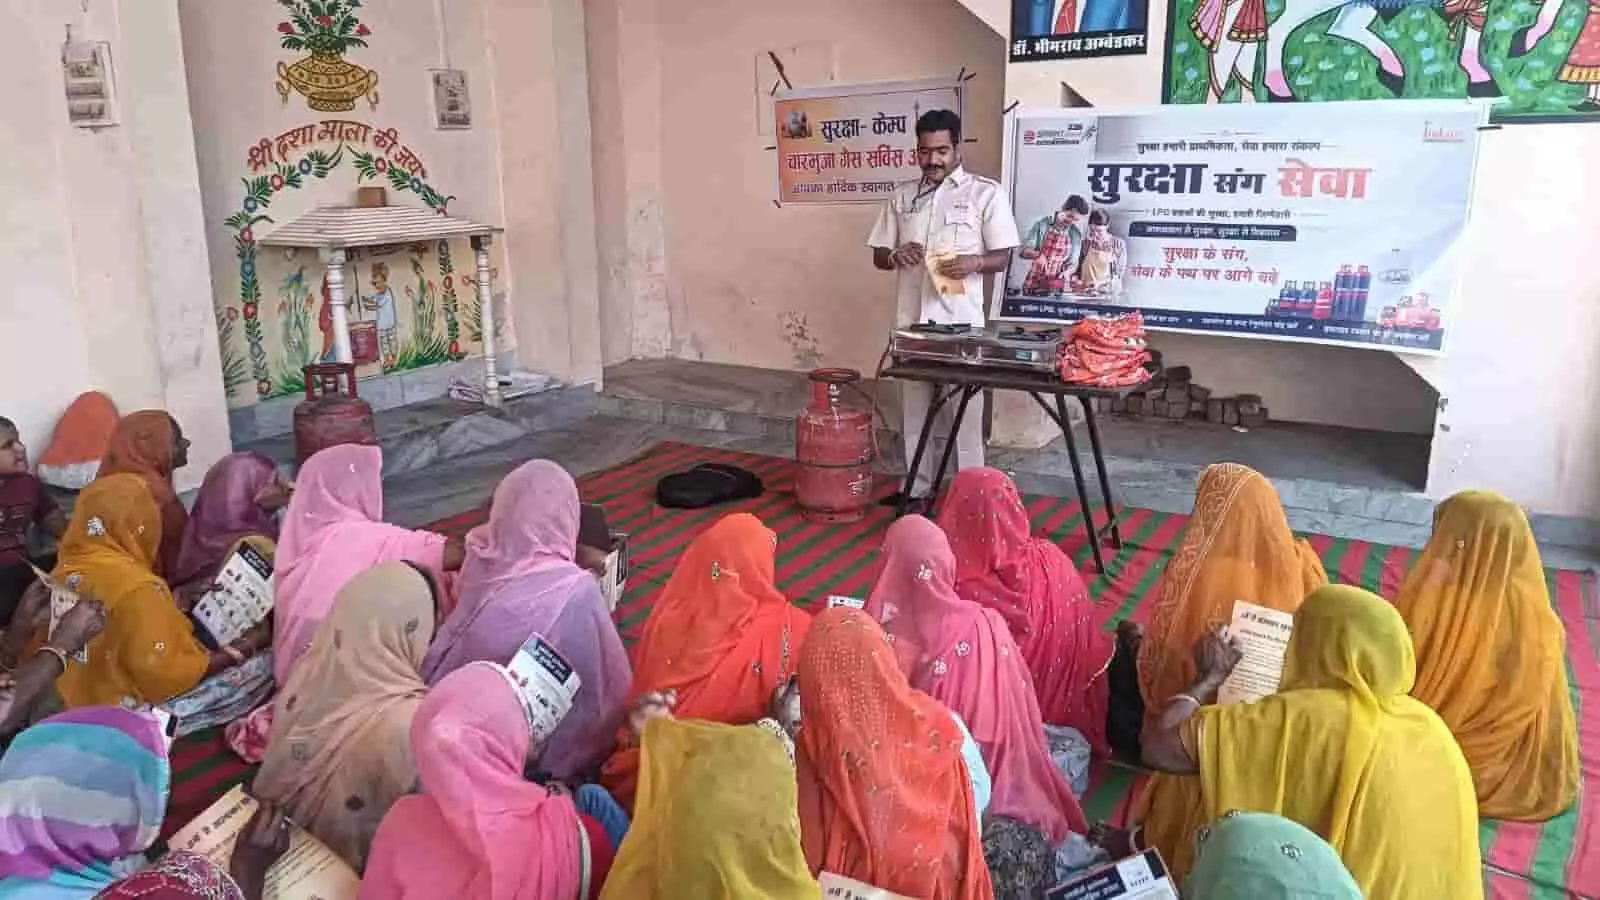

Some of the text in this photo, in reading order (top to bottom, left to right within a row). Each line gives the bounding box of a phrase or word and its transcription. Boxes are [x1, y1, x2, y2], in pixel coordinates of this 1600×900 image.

[248, 137, 273, 171] श्री
[275, 124, 316, 161] दशा
[1087, 158, 1373, 204] सुरक्षा संग सेवा
[1163, 247, 1199, 263] सुरक्षा
[1202, 243, 1217, 260] के
[1159, 264, 1171, 278] के
[1201, 268, 1220, 280] पर
[1224, 266, 1252, 283] आगे
